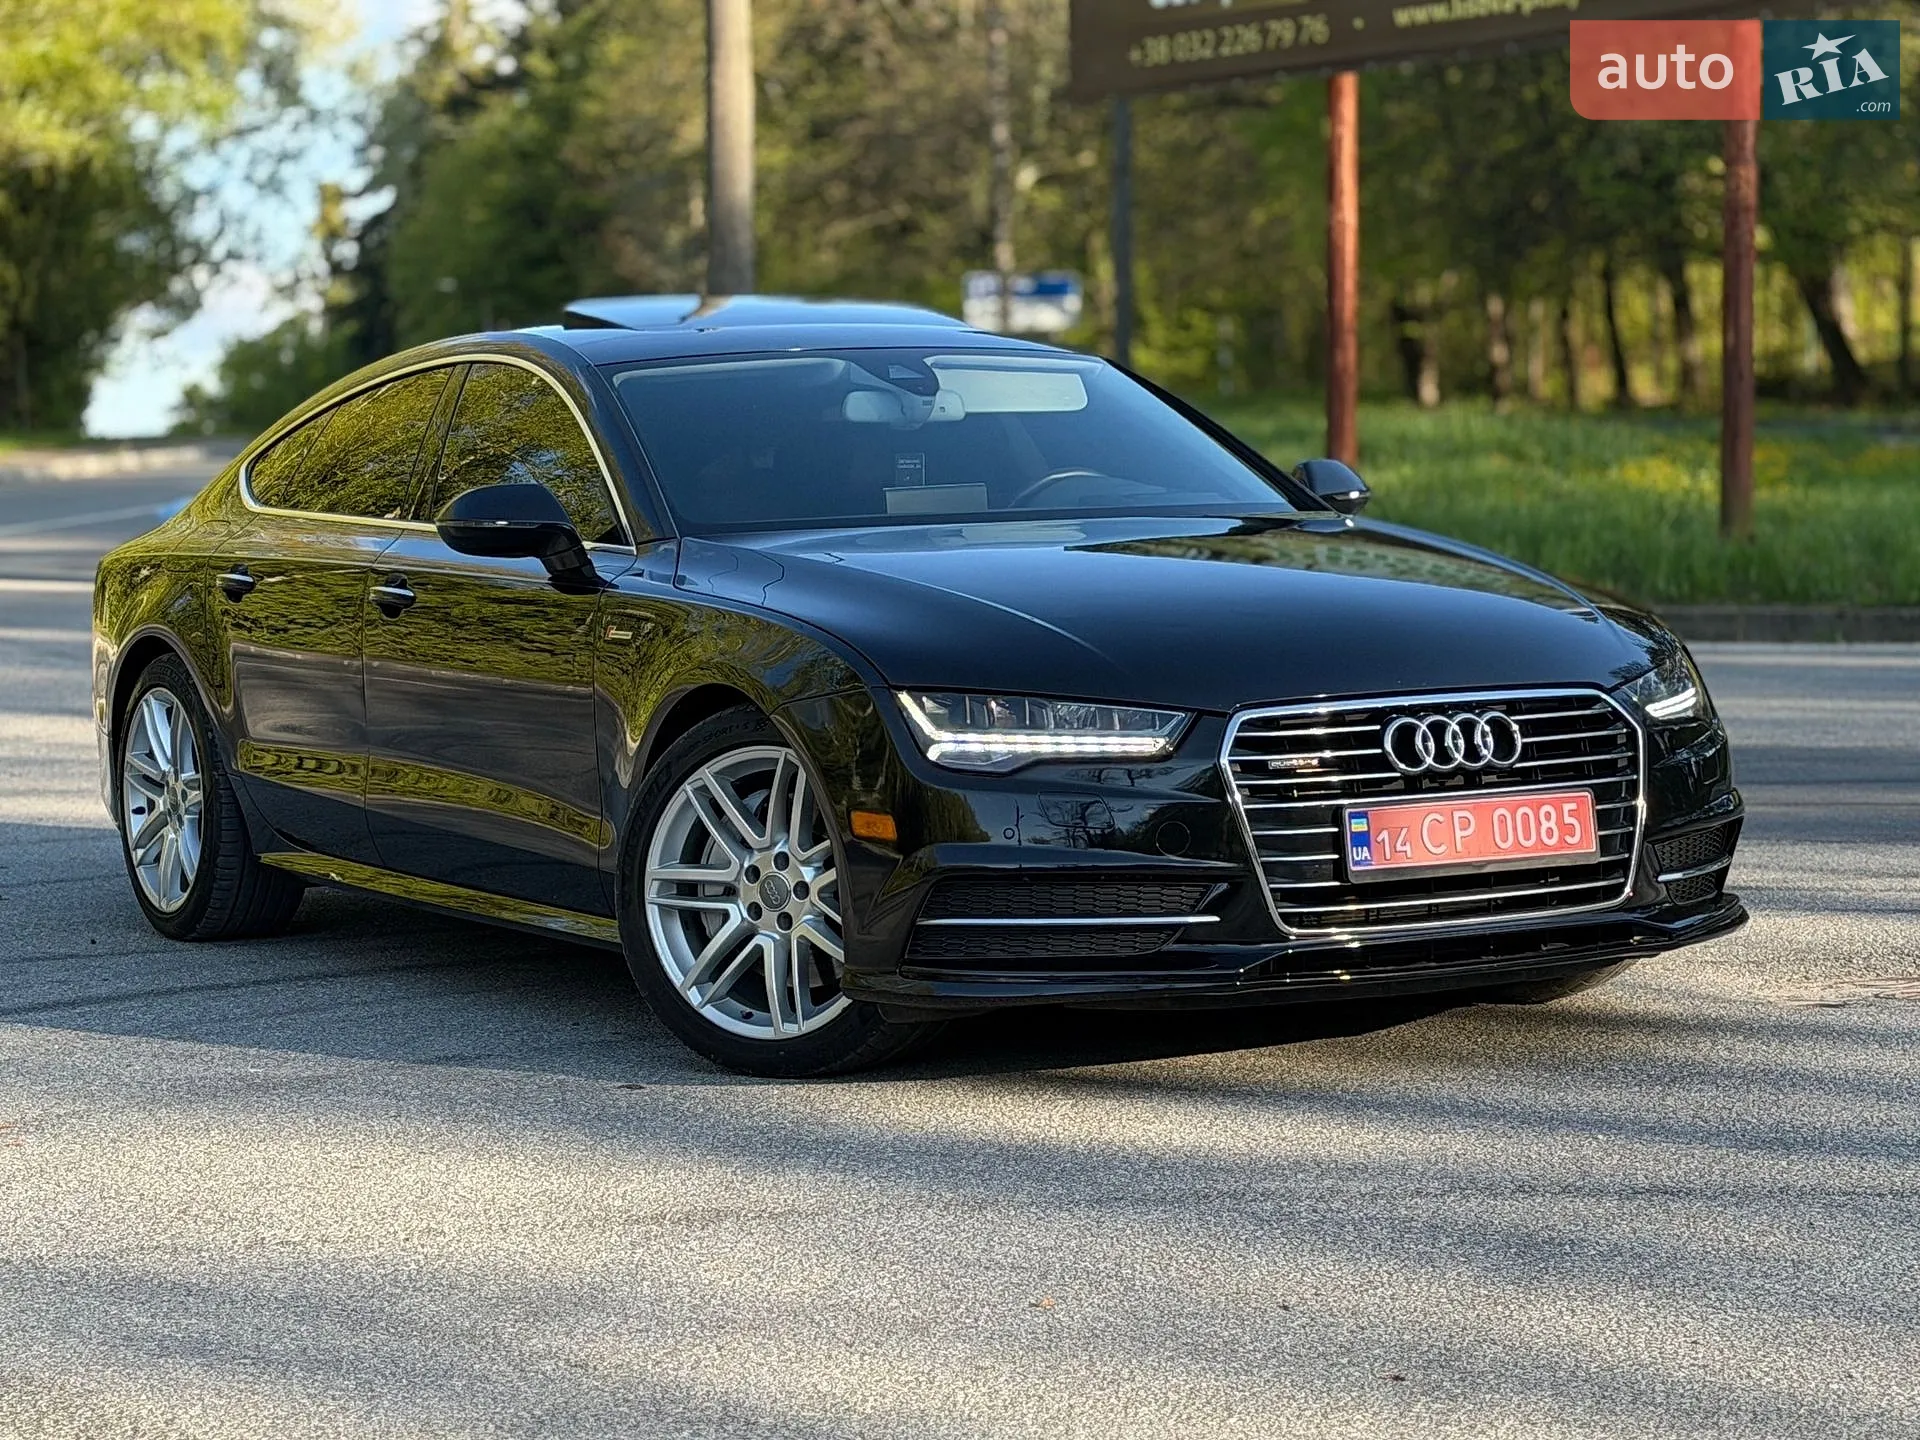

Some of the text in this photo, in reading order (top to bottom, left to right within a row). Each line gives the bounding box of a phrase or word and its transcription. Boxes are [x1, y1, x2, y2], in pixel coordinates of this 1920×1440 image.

[1127, 35, 1171, 68] +38
[1172, 28, 1217, 62] 032
[1218, 22, 1263, 57] 226
[1264, 17, 1297, 51] 79
[1297, 13, 1331, 46] 76
[1353, 846, 1371, 861] UA
[1375, 802, 1583, 861] 14 CP 0085
